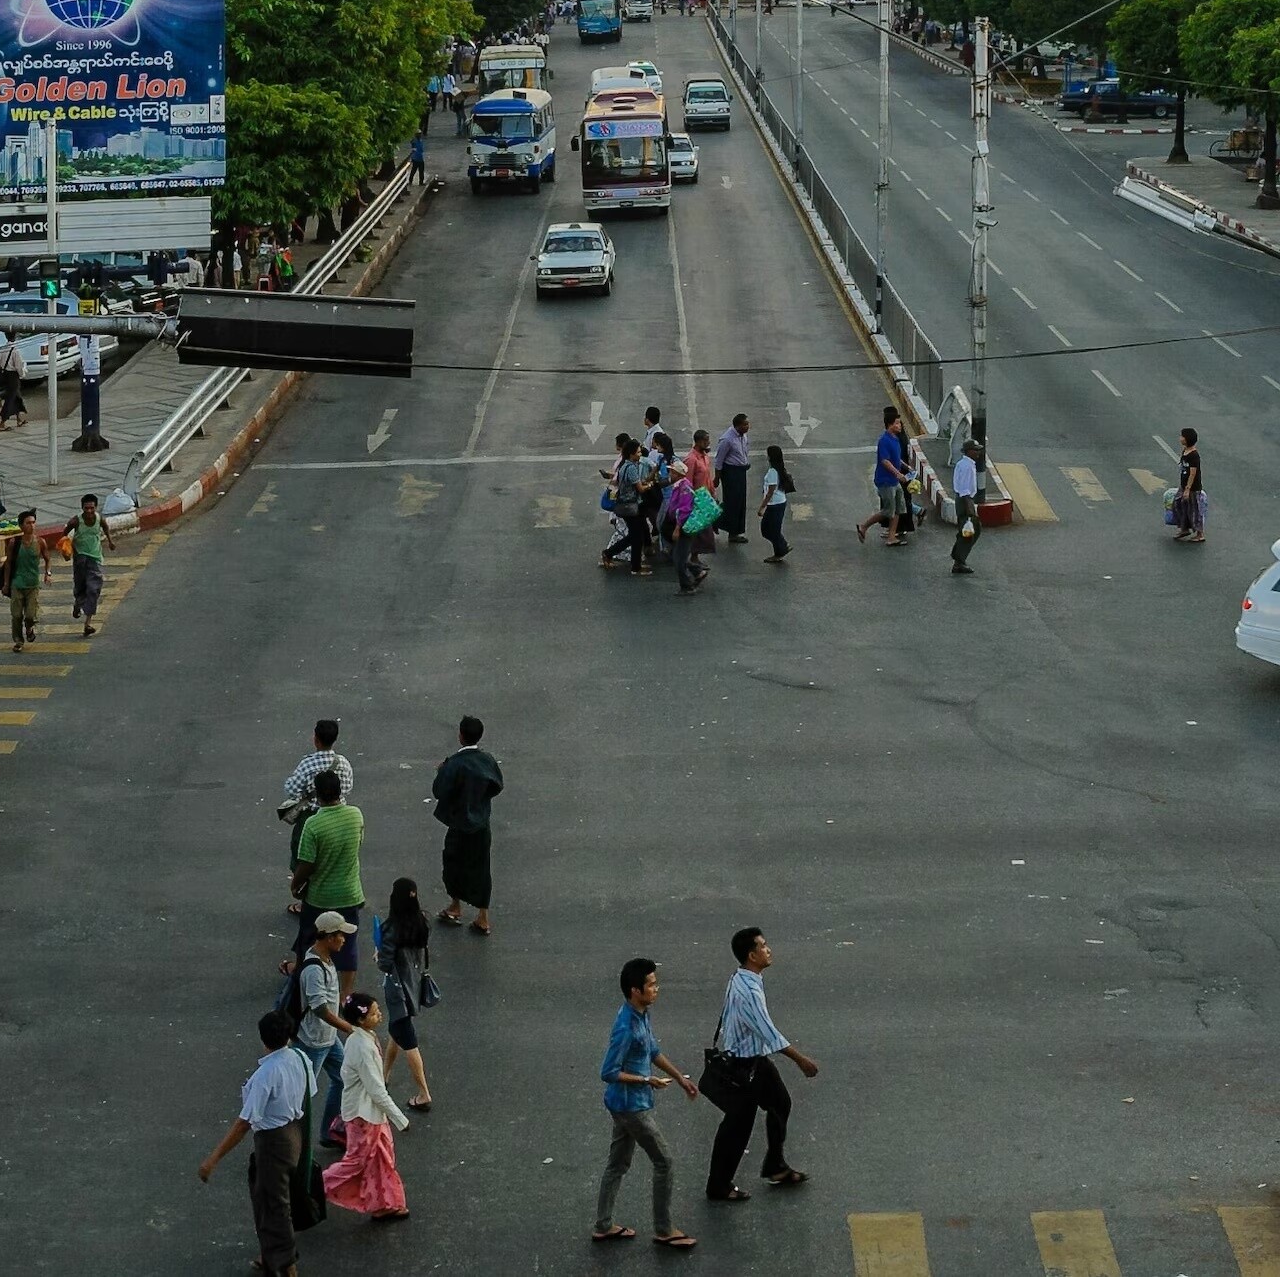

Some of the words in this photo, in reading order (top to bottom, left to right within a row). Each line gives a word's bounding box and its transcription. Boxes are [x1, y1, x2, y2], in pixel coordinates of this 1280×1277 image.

[55, 41, 85, 51] Since
[88, 40, 112, 50] 1996
[116, 73, 187, 99] Lion
[10, 108, 51, 122] Wire
[53, 106, 66, 121] &
[68, 104, 117, 120] Cable
